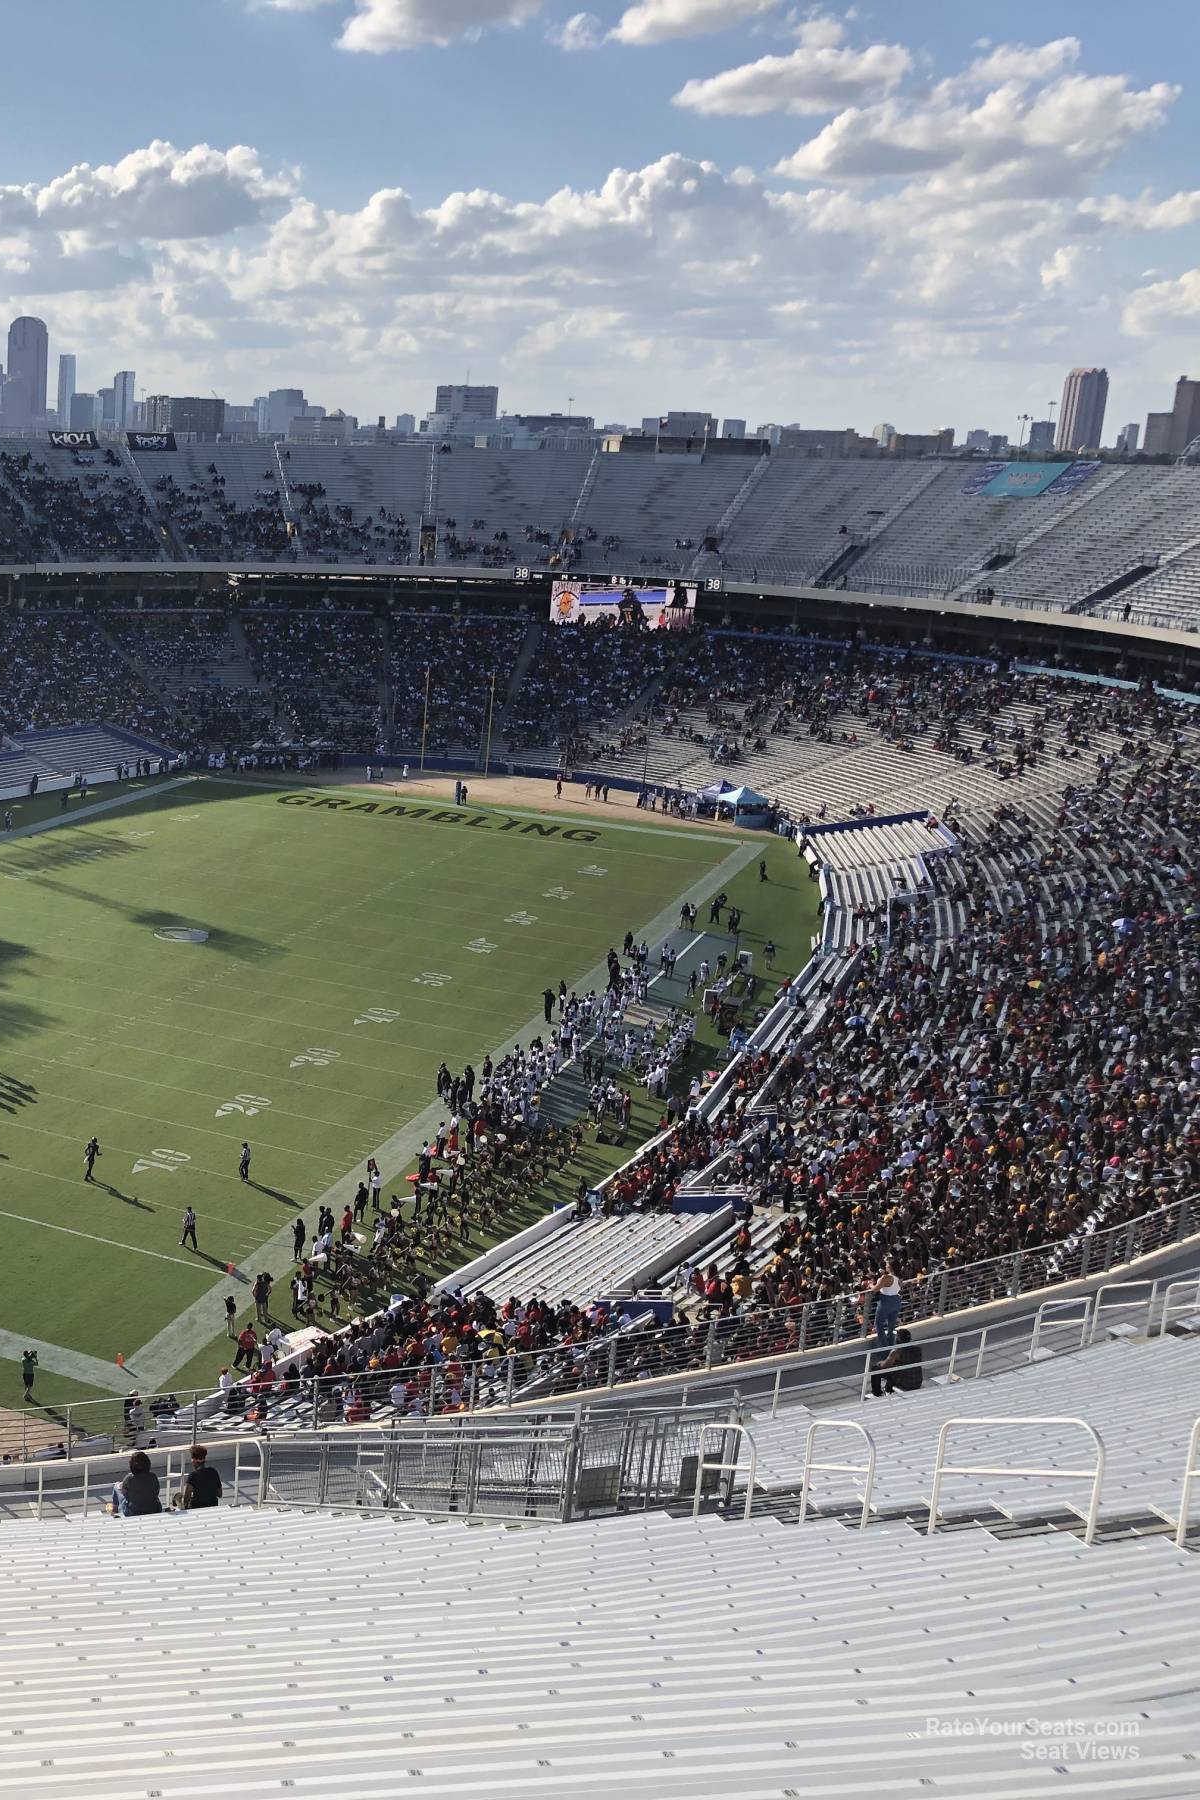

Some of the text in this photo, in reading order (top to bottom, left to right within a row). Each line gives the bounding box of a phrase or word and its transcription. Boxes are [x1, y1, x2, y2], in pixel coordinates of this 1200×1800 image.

[516, 568, 528, 578] 38
[707, 578, 720, 590] 38
[276, 795, 602, 842] GRAMBLING
[412, 971, 453, 987] 50
[360, 1007, 401, 1024] 40
[292, 1047, 342, 1066] 30
[220, 1094, 273, 1116] 20
[138, 1148, 192, 1172] 10
